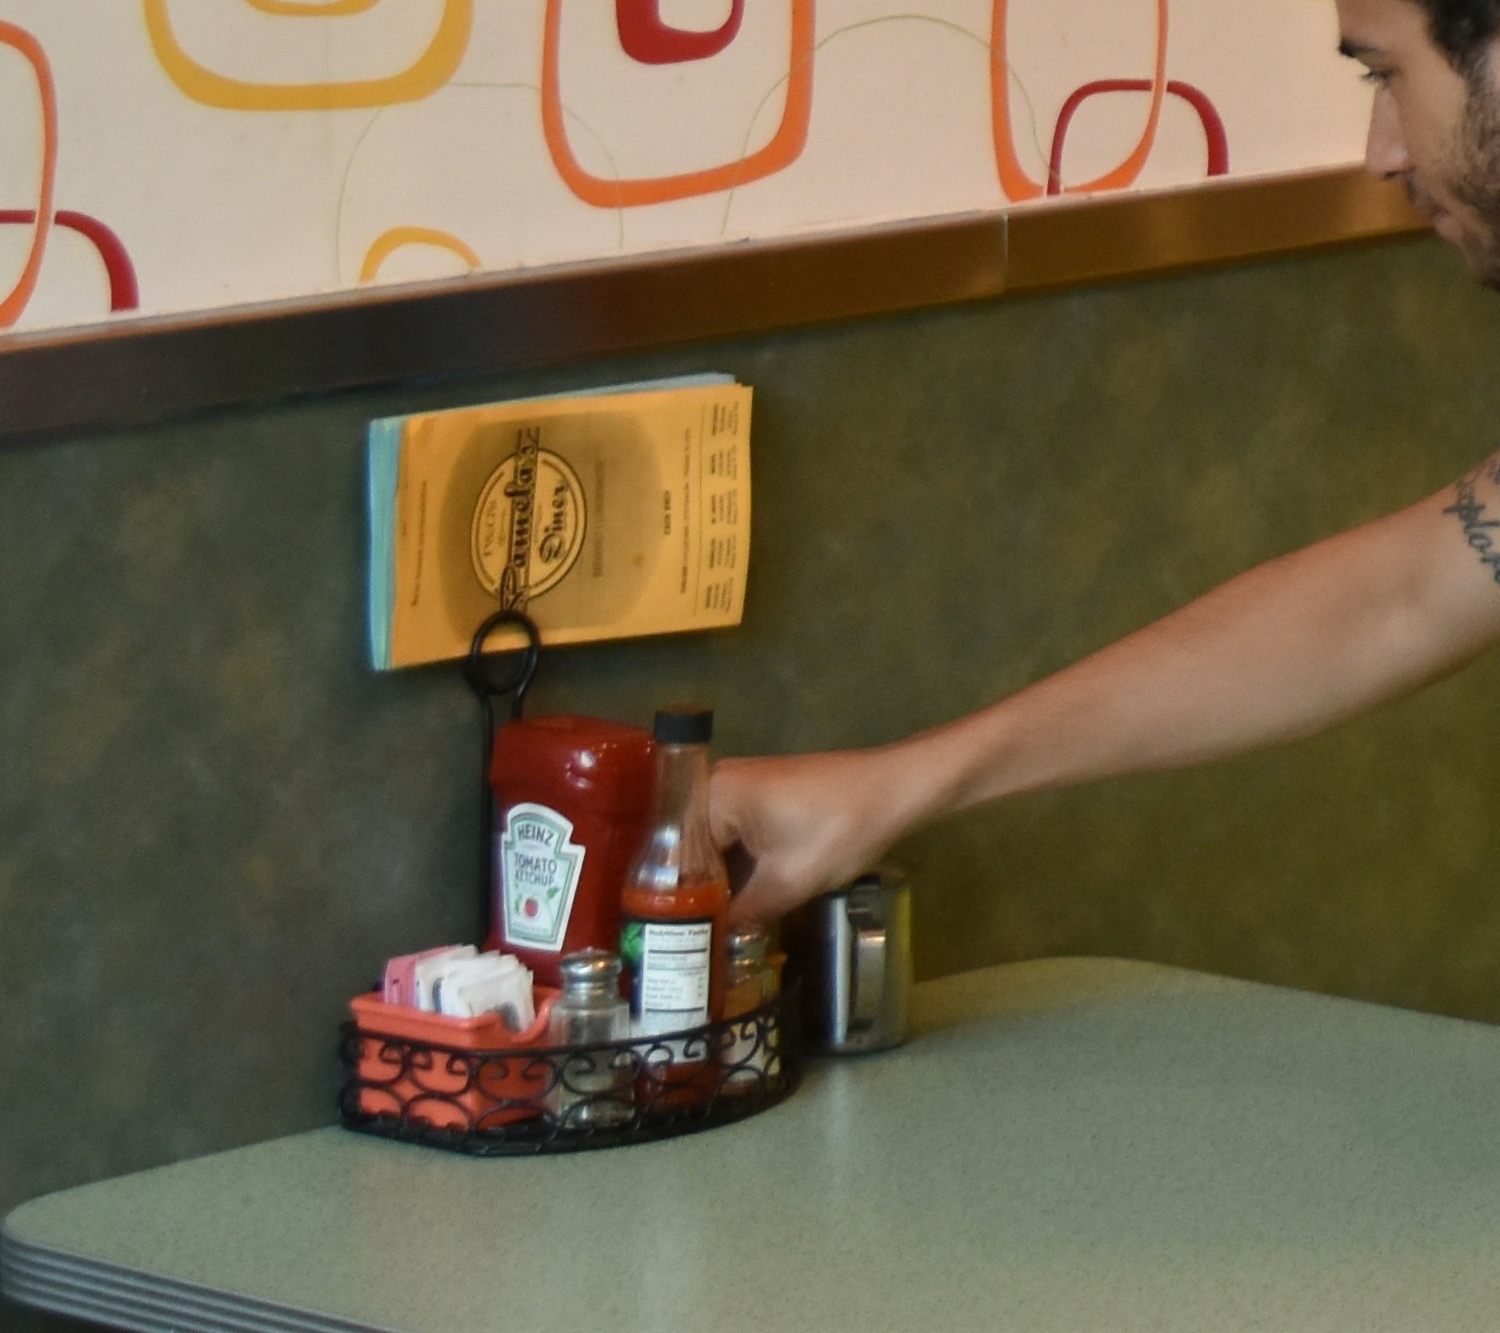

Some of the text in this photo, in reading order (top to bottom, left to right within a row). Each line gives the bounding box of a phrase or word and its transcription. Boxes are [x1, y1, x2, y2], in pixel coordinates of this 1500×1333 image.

[540, 478, 569, 563] Diner
[517, 824, 554, 846] HEINZ
[514, 852, 557, 873] TOMATO
[515, 868, 555, 887] KETCHUP
